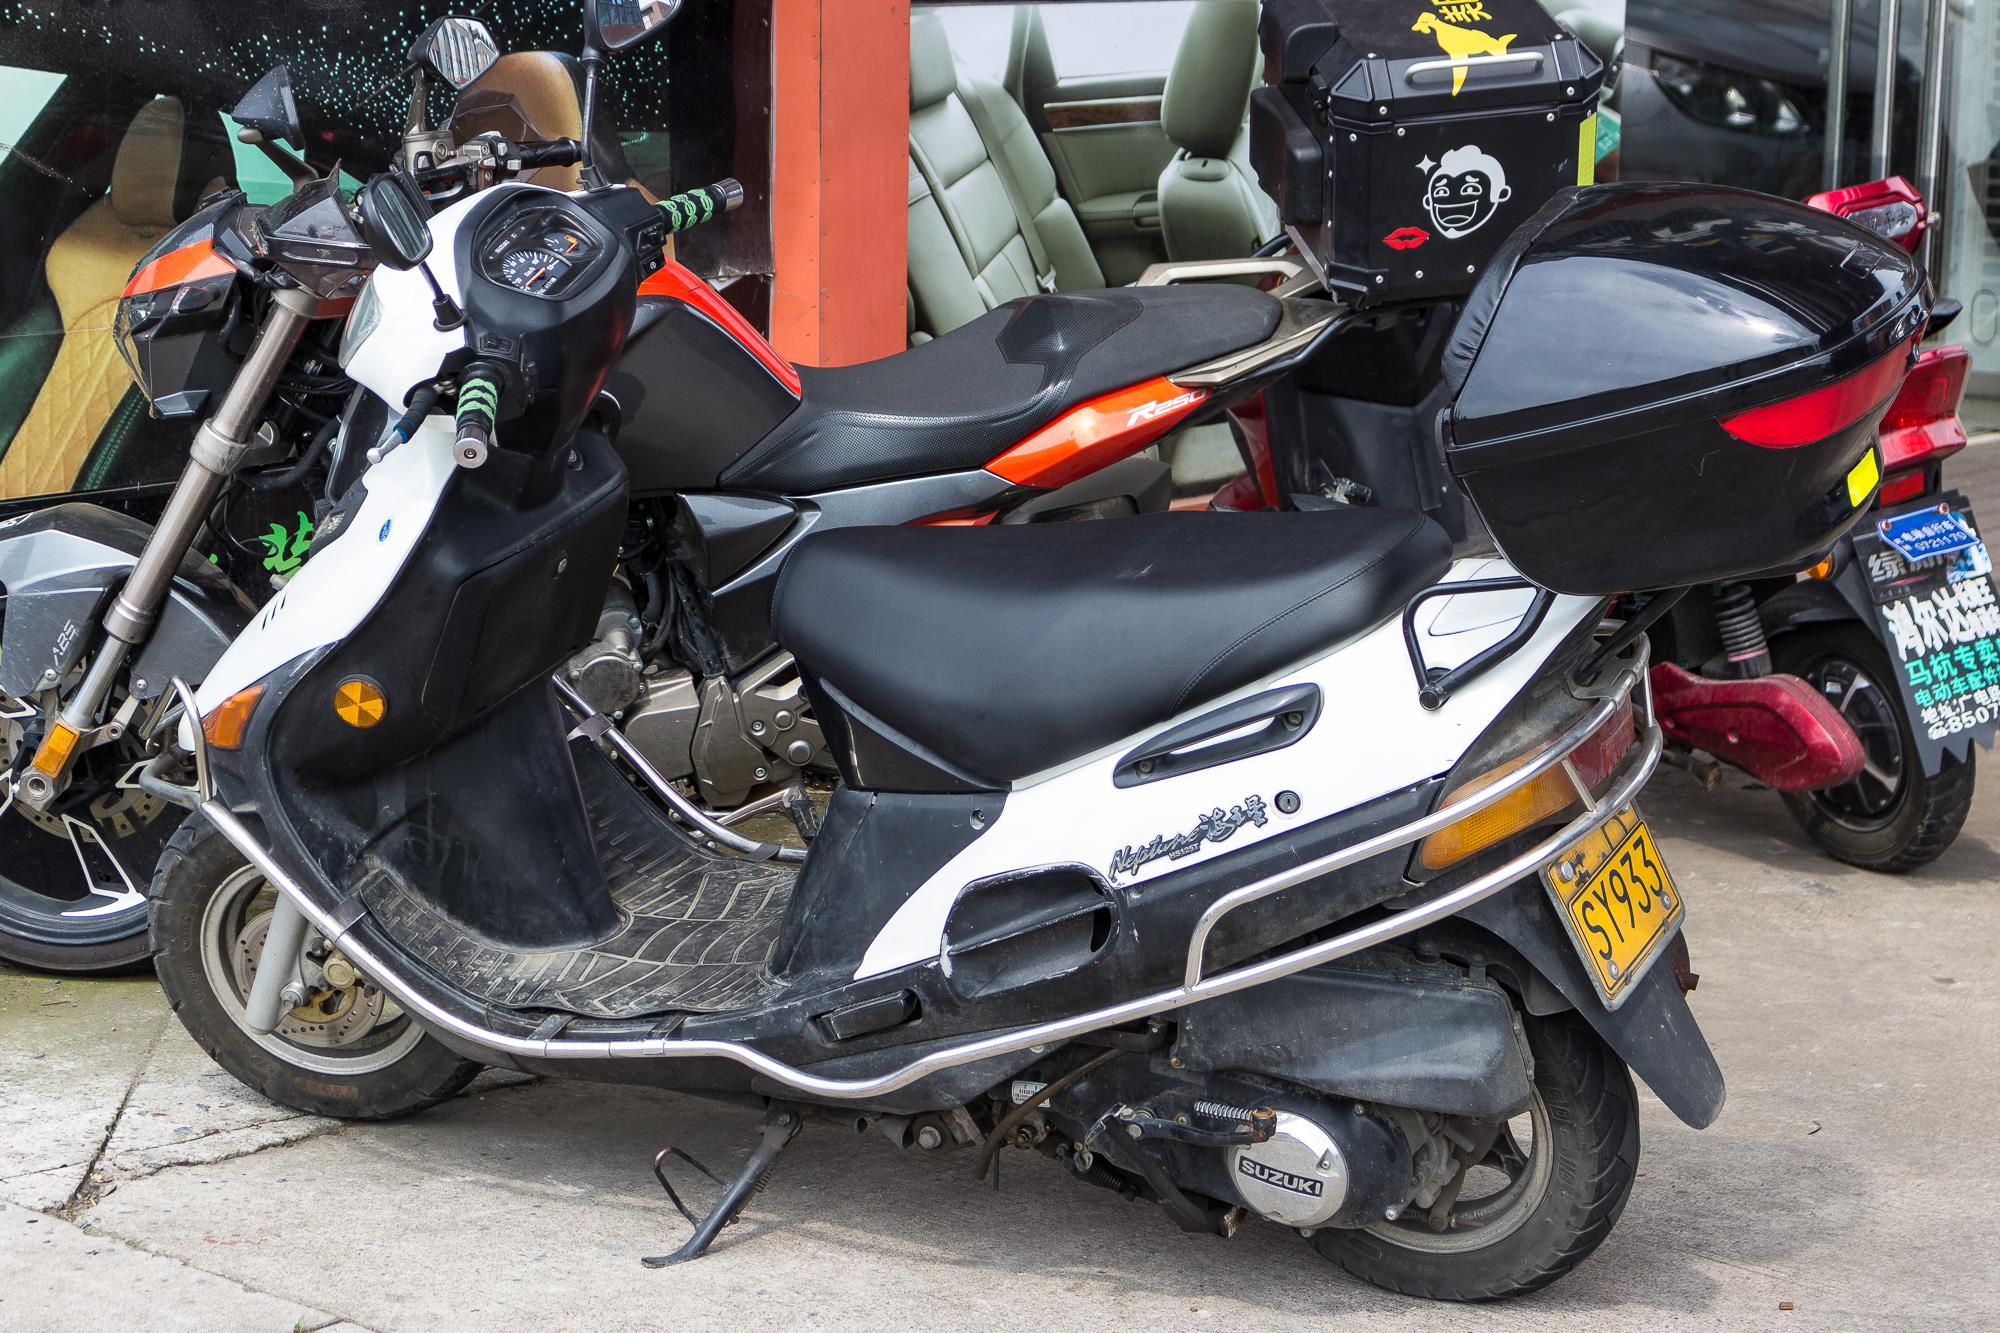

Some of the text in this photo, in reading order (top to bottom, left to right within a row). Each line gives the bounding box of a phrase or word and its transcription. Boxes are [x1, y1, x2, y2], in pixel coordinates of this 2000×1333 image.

[1126, 387, 1207, 427] R250
[1914, 531, 1967, 552] 0721170
[53, 619, 77, 666] ABS
[1904, 637, 2000, 687] 马杭专卖
[1913, 663, 2000, 708] 电动车配件
[1108, 794, 1268, 882] Neptune 海王星
[1582, 836, 1663, 961] SY933
[1241, 1159, 1321, 1195] SUZUKI
